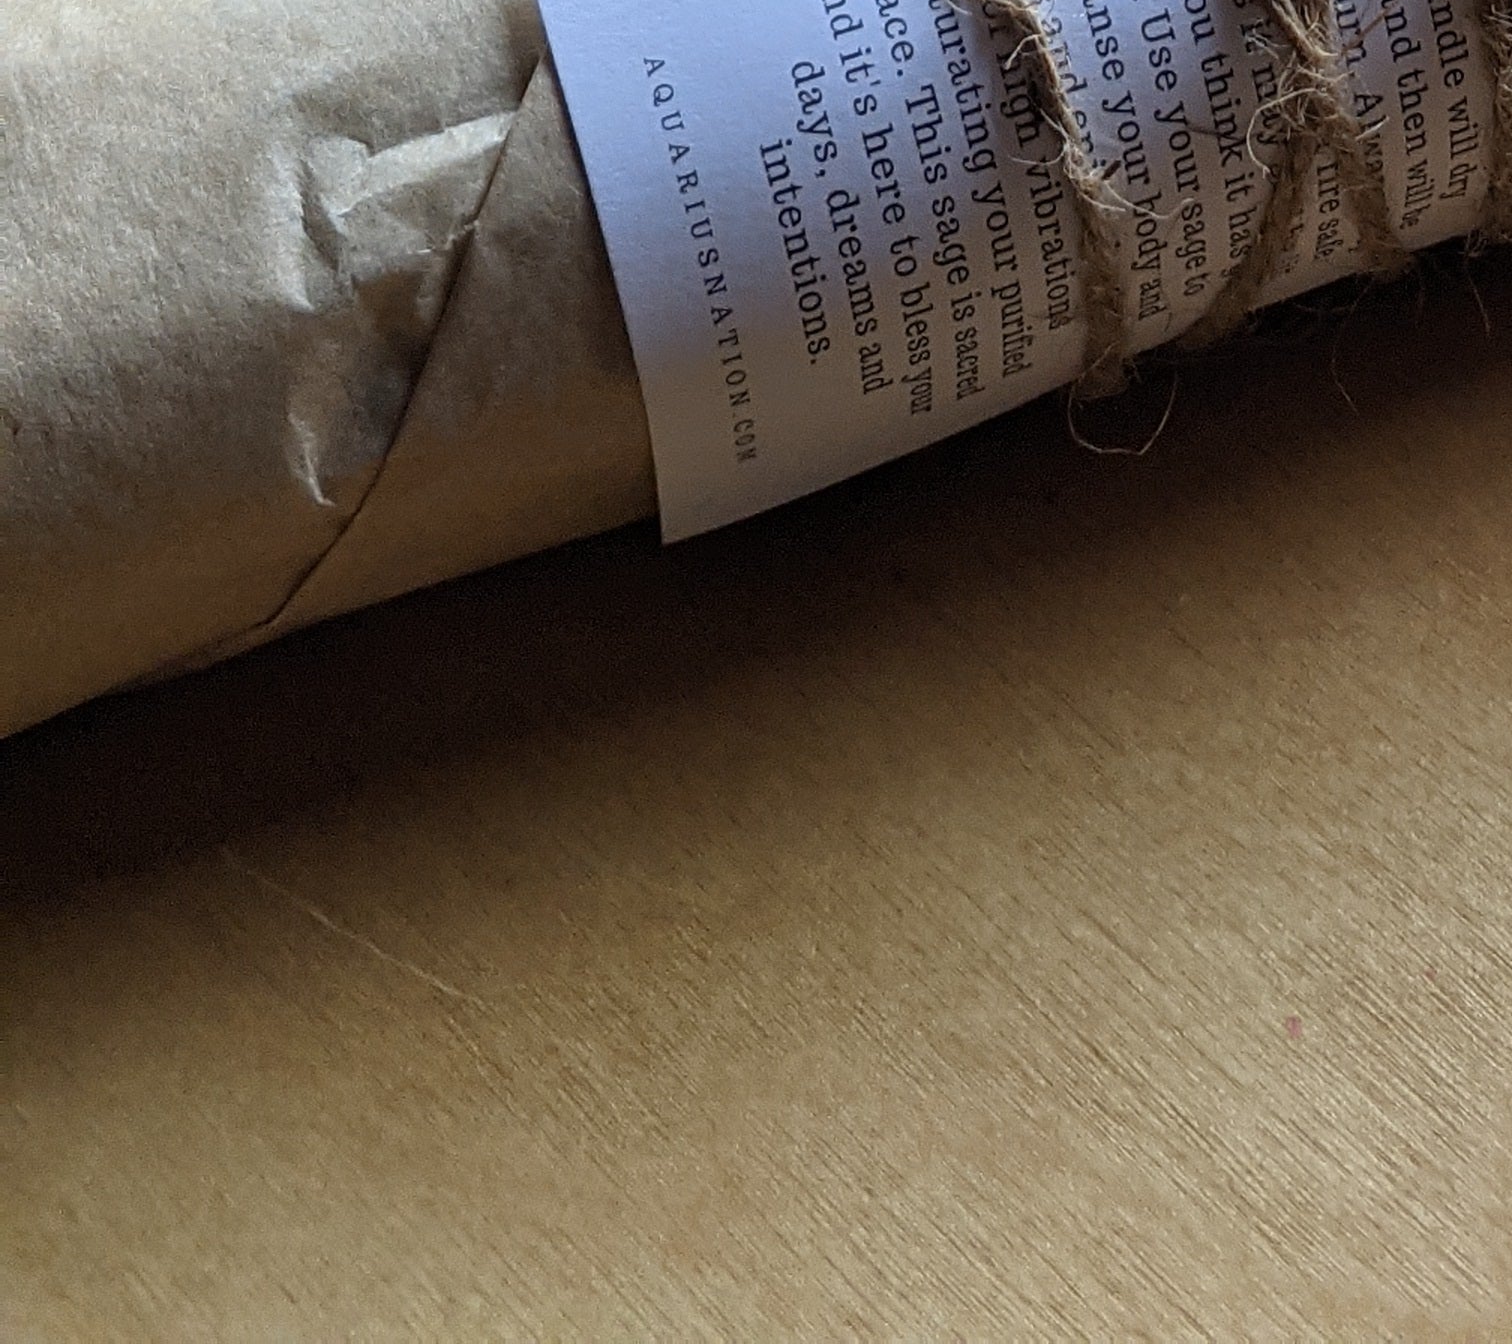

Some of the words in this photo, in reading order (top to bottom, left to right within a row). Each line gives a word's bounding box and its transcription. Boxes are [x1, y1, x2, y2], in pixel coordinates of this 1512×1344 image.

[839, 47, 883, 116] it's
[1140, 8, 1179, 91] Use
[905, 85, 950, 184] This
[1103, 89, 1149, 186] your
[1201, 50, 1246, 157] think
[1395, 69, 1428, 154] then
[1446, 96, 1480, 157] will
[862, 124, 907, 224] here
[1155, 99, 1199, 194] your
[1223, 159, 1250, 203] it
[1404, 159, 1434, 207] will
[1440, 159, 1471, 201] dry
[759, 139, 834, 366] intentions.
[791, 61, 839, 179] days,
[823, 190, 880, 337] dreams
[858, 334, 895, 395] and
[891, 234, 917, 276] to
[933, 193, 971, 286] sage
[1026, 162, 1078, 329] vibrations
[1132, 186, 1168, 271] body
[1175, 202, 1206, 266] sage
[1228, 208, 1256, 262] has
[954, 288, 977, 318] is
[971, 181, 1019, 274] your
[1000, 279, 1036, 377] purified
[1139, 268, 1168, 318] and
[1184, 268, 1207, 297] to
[901, 284, 935, 364] bless
[951, 318, 985, 400] sacred
[905, 365, 933, 415] your
